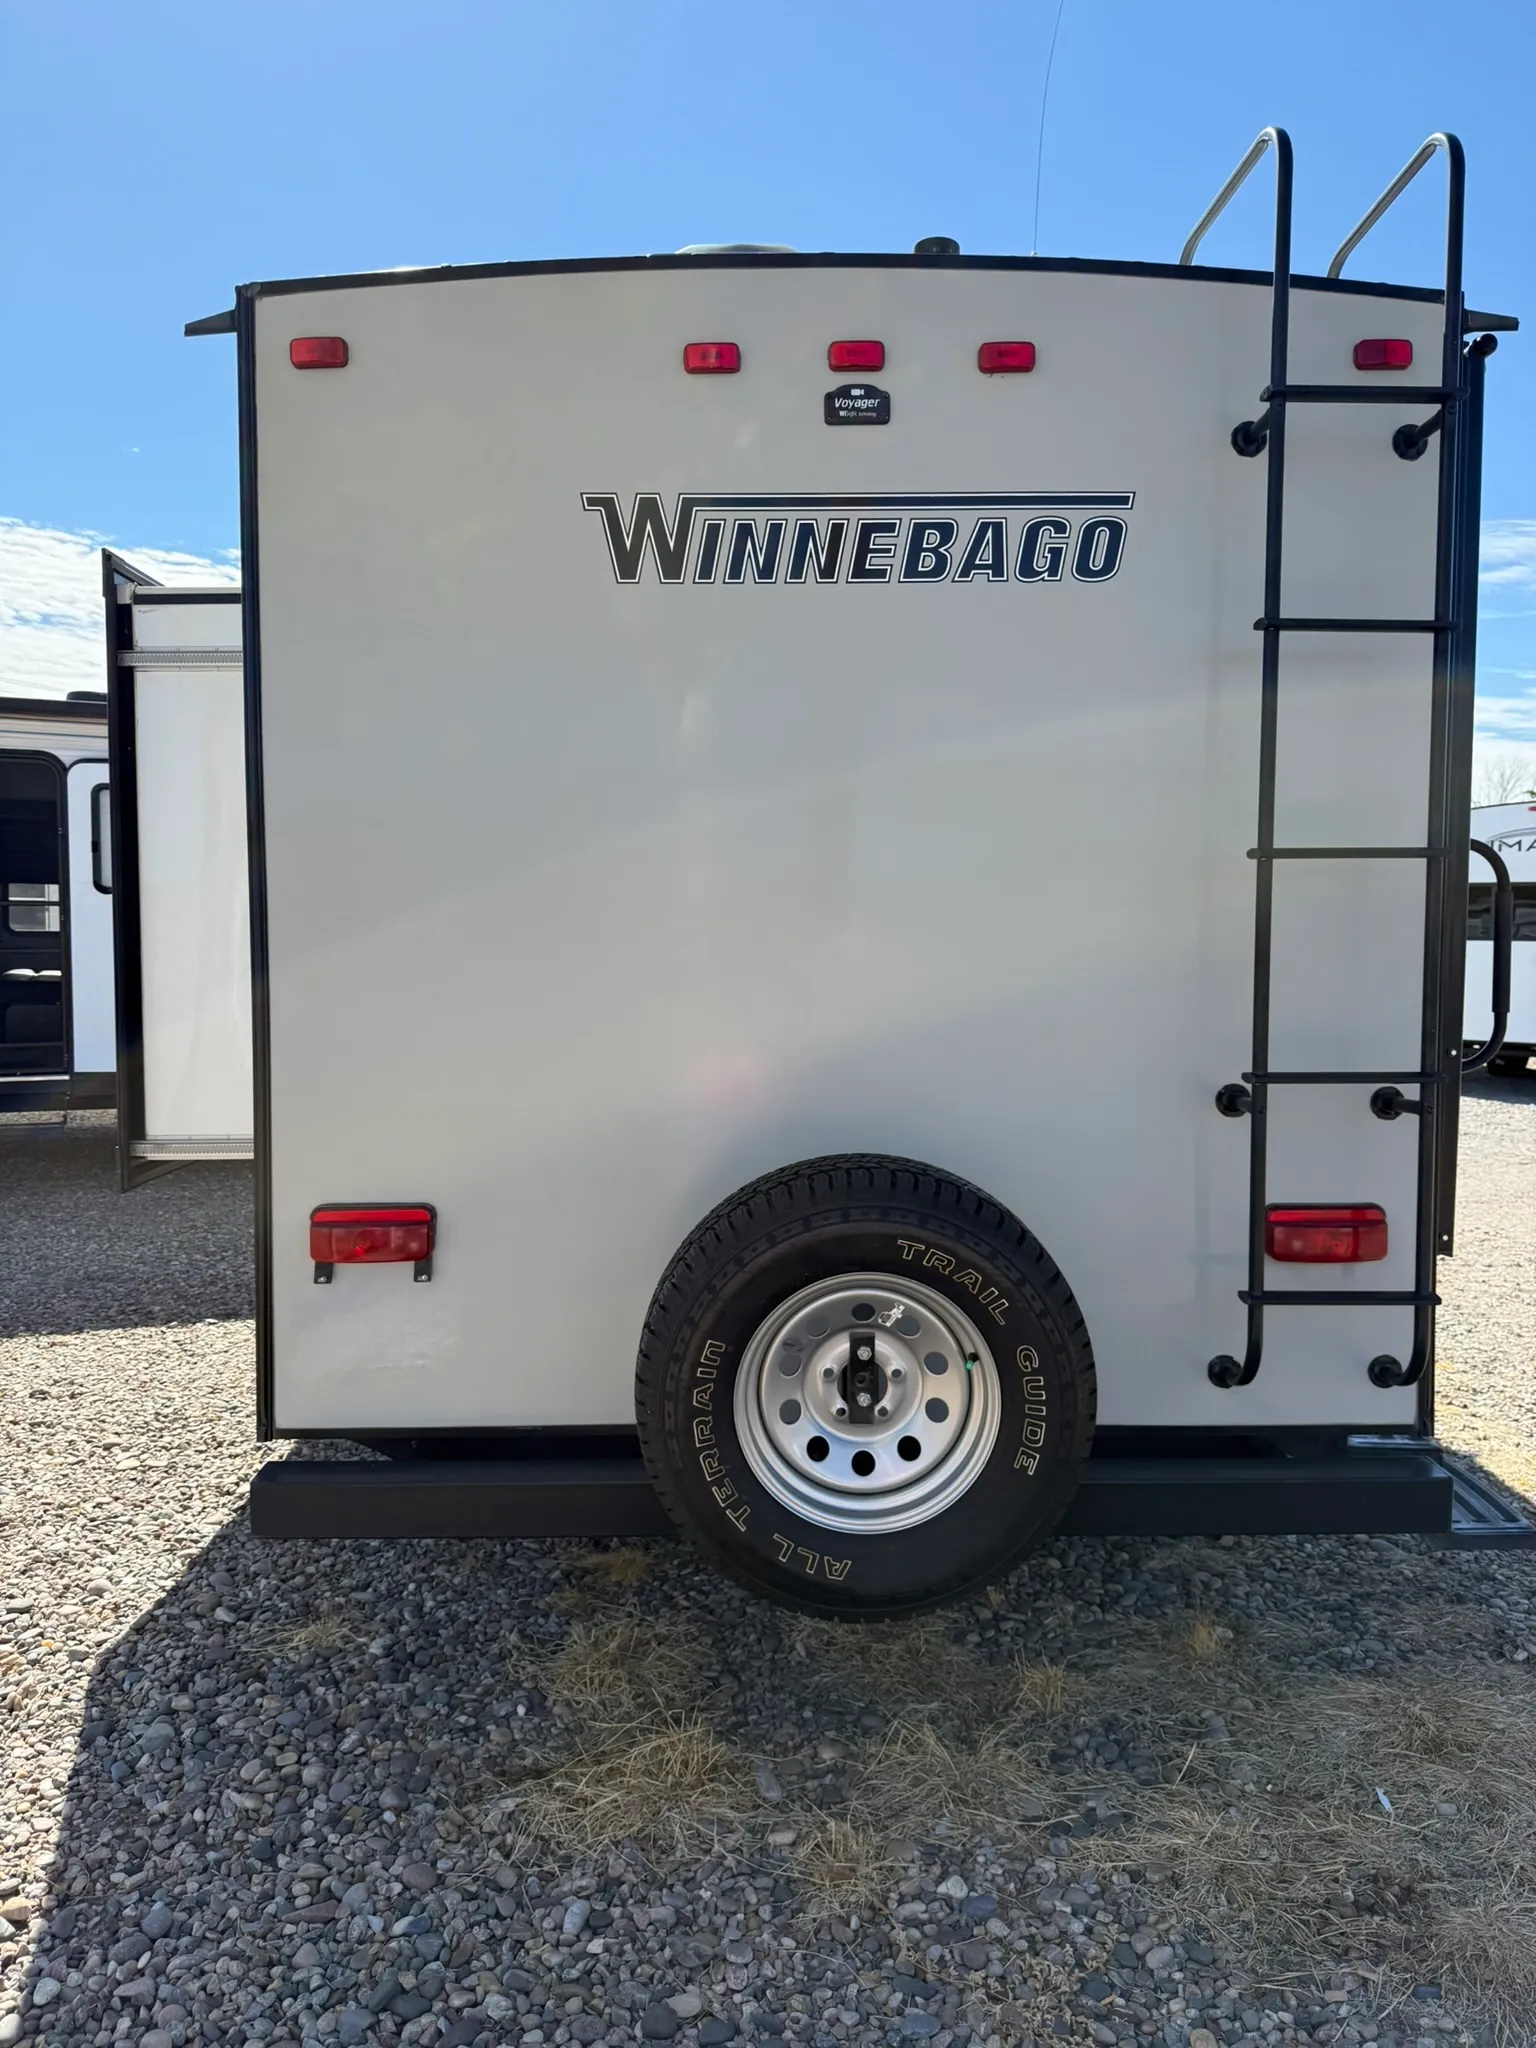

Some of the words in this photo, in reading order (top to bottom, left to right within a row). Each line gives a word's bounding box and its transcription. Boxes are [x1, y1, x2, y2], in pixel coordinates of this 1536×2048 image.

[834, 397, 881, 409] Voyager
[580, 491, 1136, 585] WINNEBAGO
[897, 1239, 1012, 1327] TRAIL
[1013, 1344, 1047, 1477] GUIDE
[692, 1339, 752, 1533] TERRAIN
[772, 1532, 852, 1581] ALL
